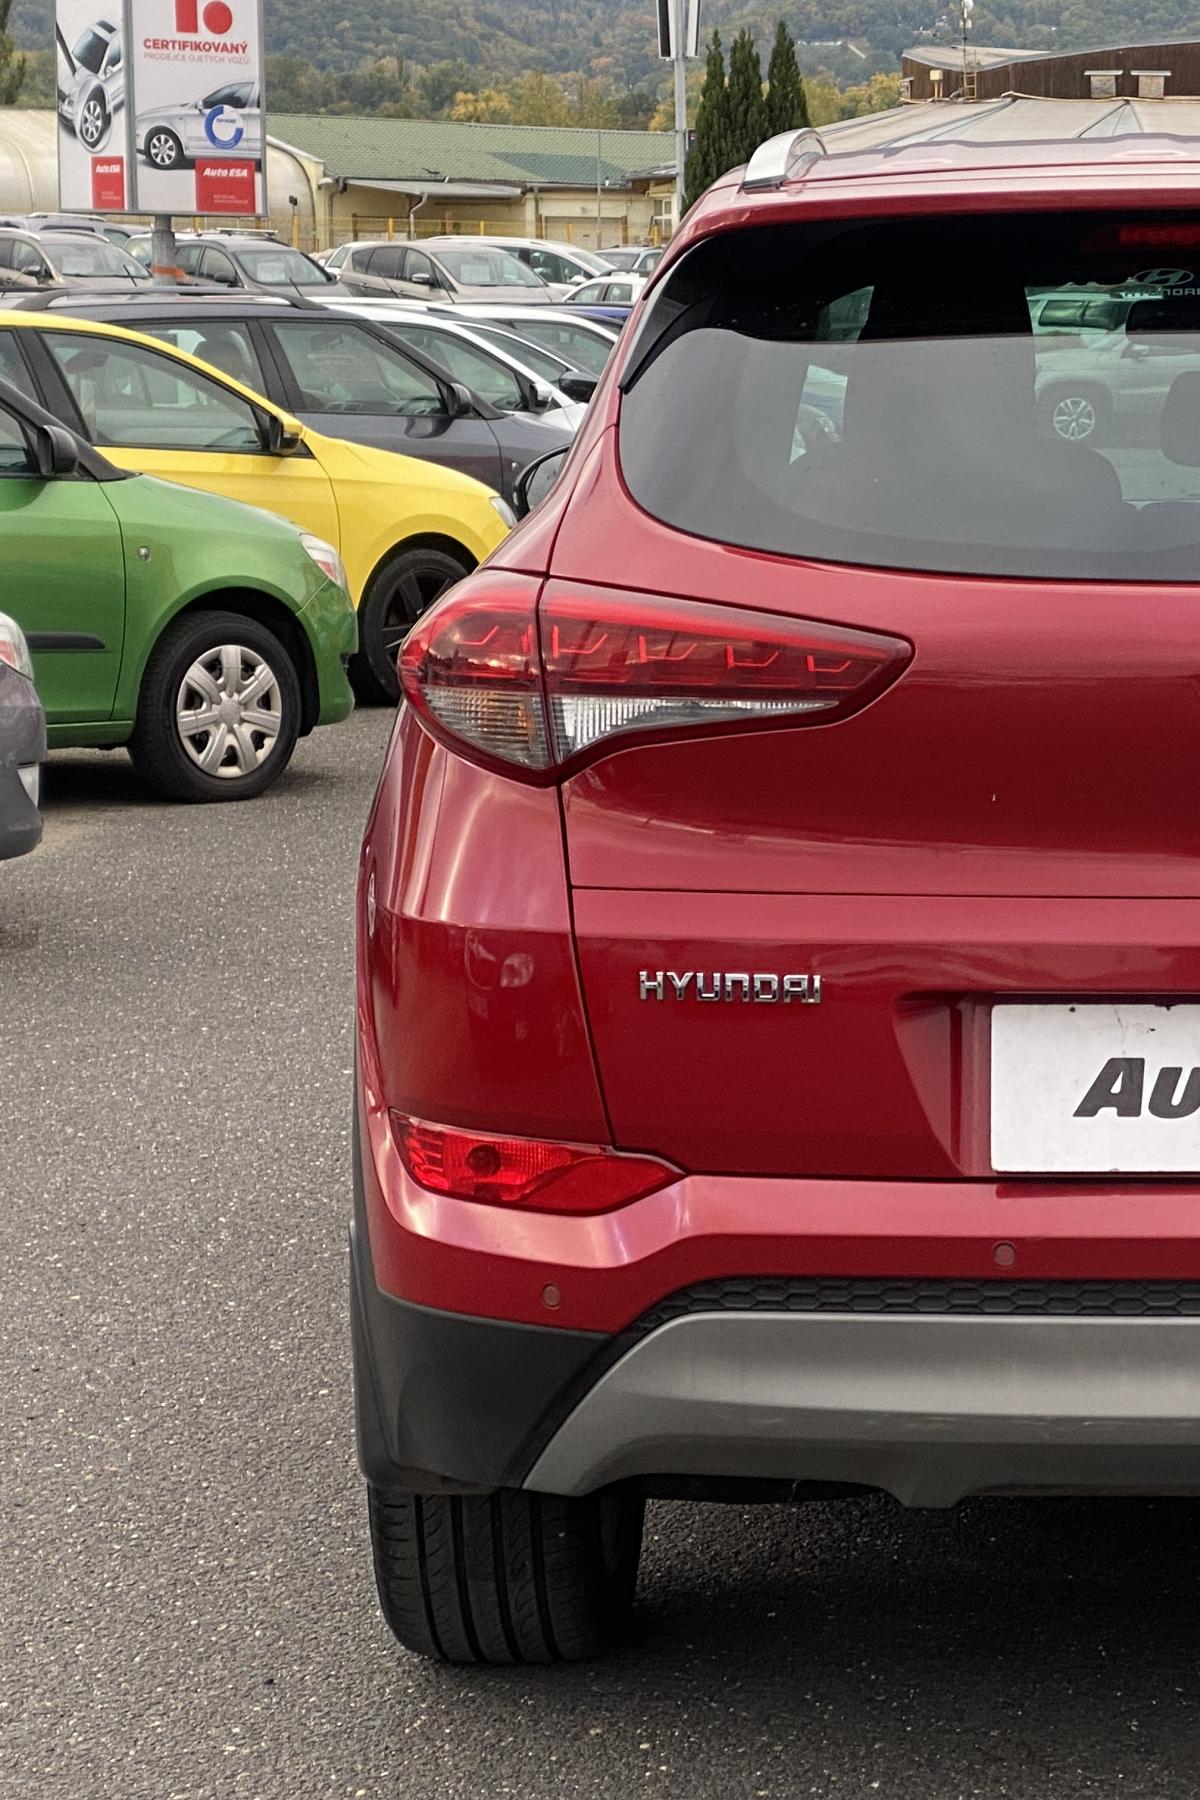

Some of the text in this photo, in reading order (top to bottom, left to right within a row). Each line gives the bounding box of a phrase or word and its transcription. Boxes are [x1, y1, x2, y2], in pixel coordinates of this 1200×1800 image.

[143, 38, 248, 54] CERTIFIKOVANÝ
[203, 167, 248, 178] Auto ESA
[639, 971, 822, 1004] HYUNDAI
